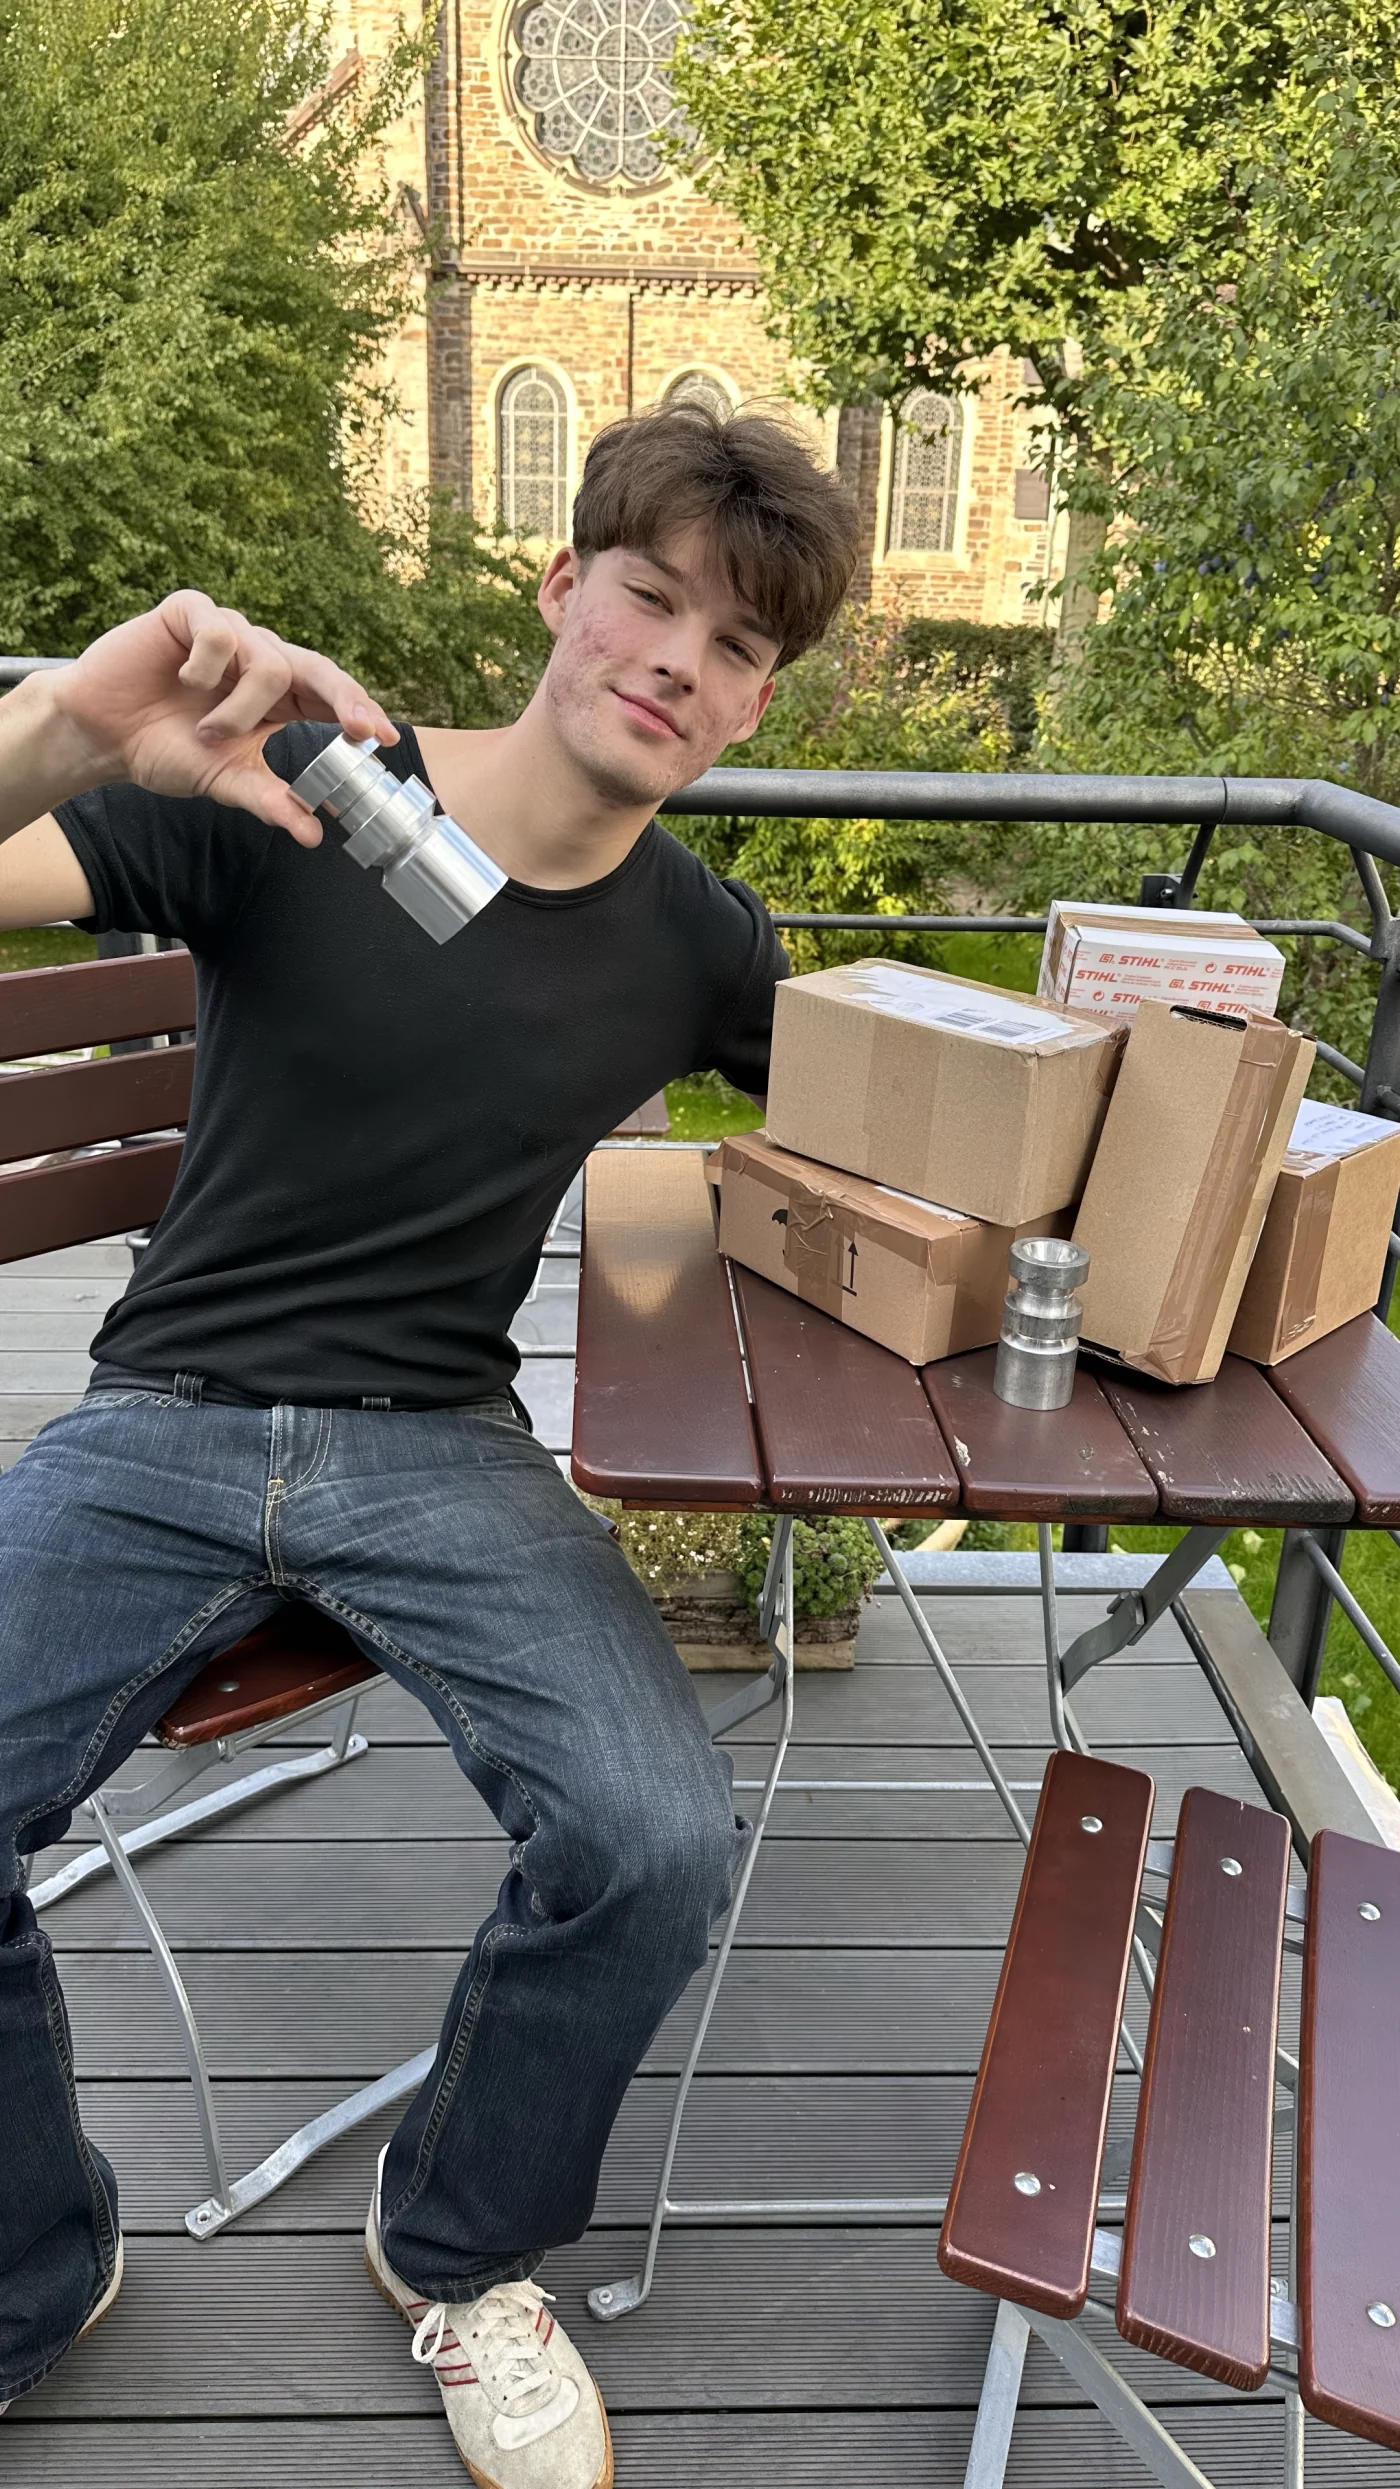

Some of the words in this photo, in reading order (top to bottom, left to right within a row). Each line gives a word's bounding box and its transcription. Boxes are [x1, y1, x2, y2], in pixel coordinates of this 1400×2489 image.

[1118, 955, 1161, 968] STIHL
[1075, 969, 1117, 982] STIHL
[1223, 964, 1267, 977] STIHL
[1188, 981, 1231, 993] STIHL
